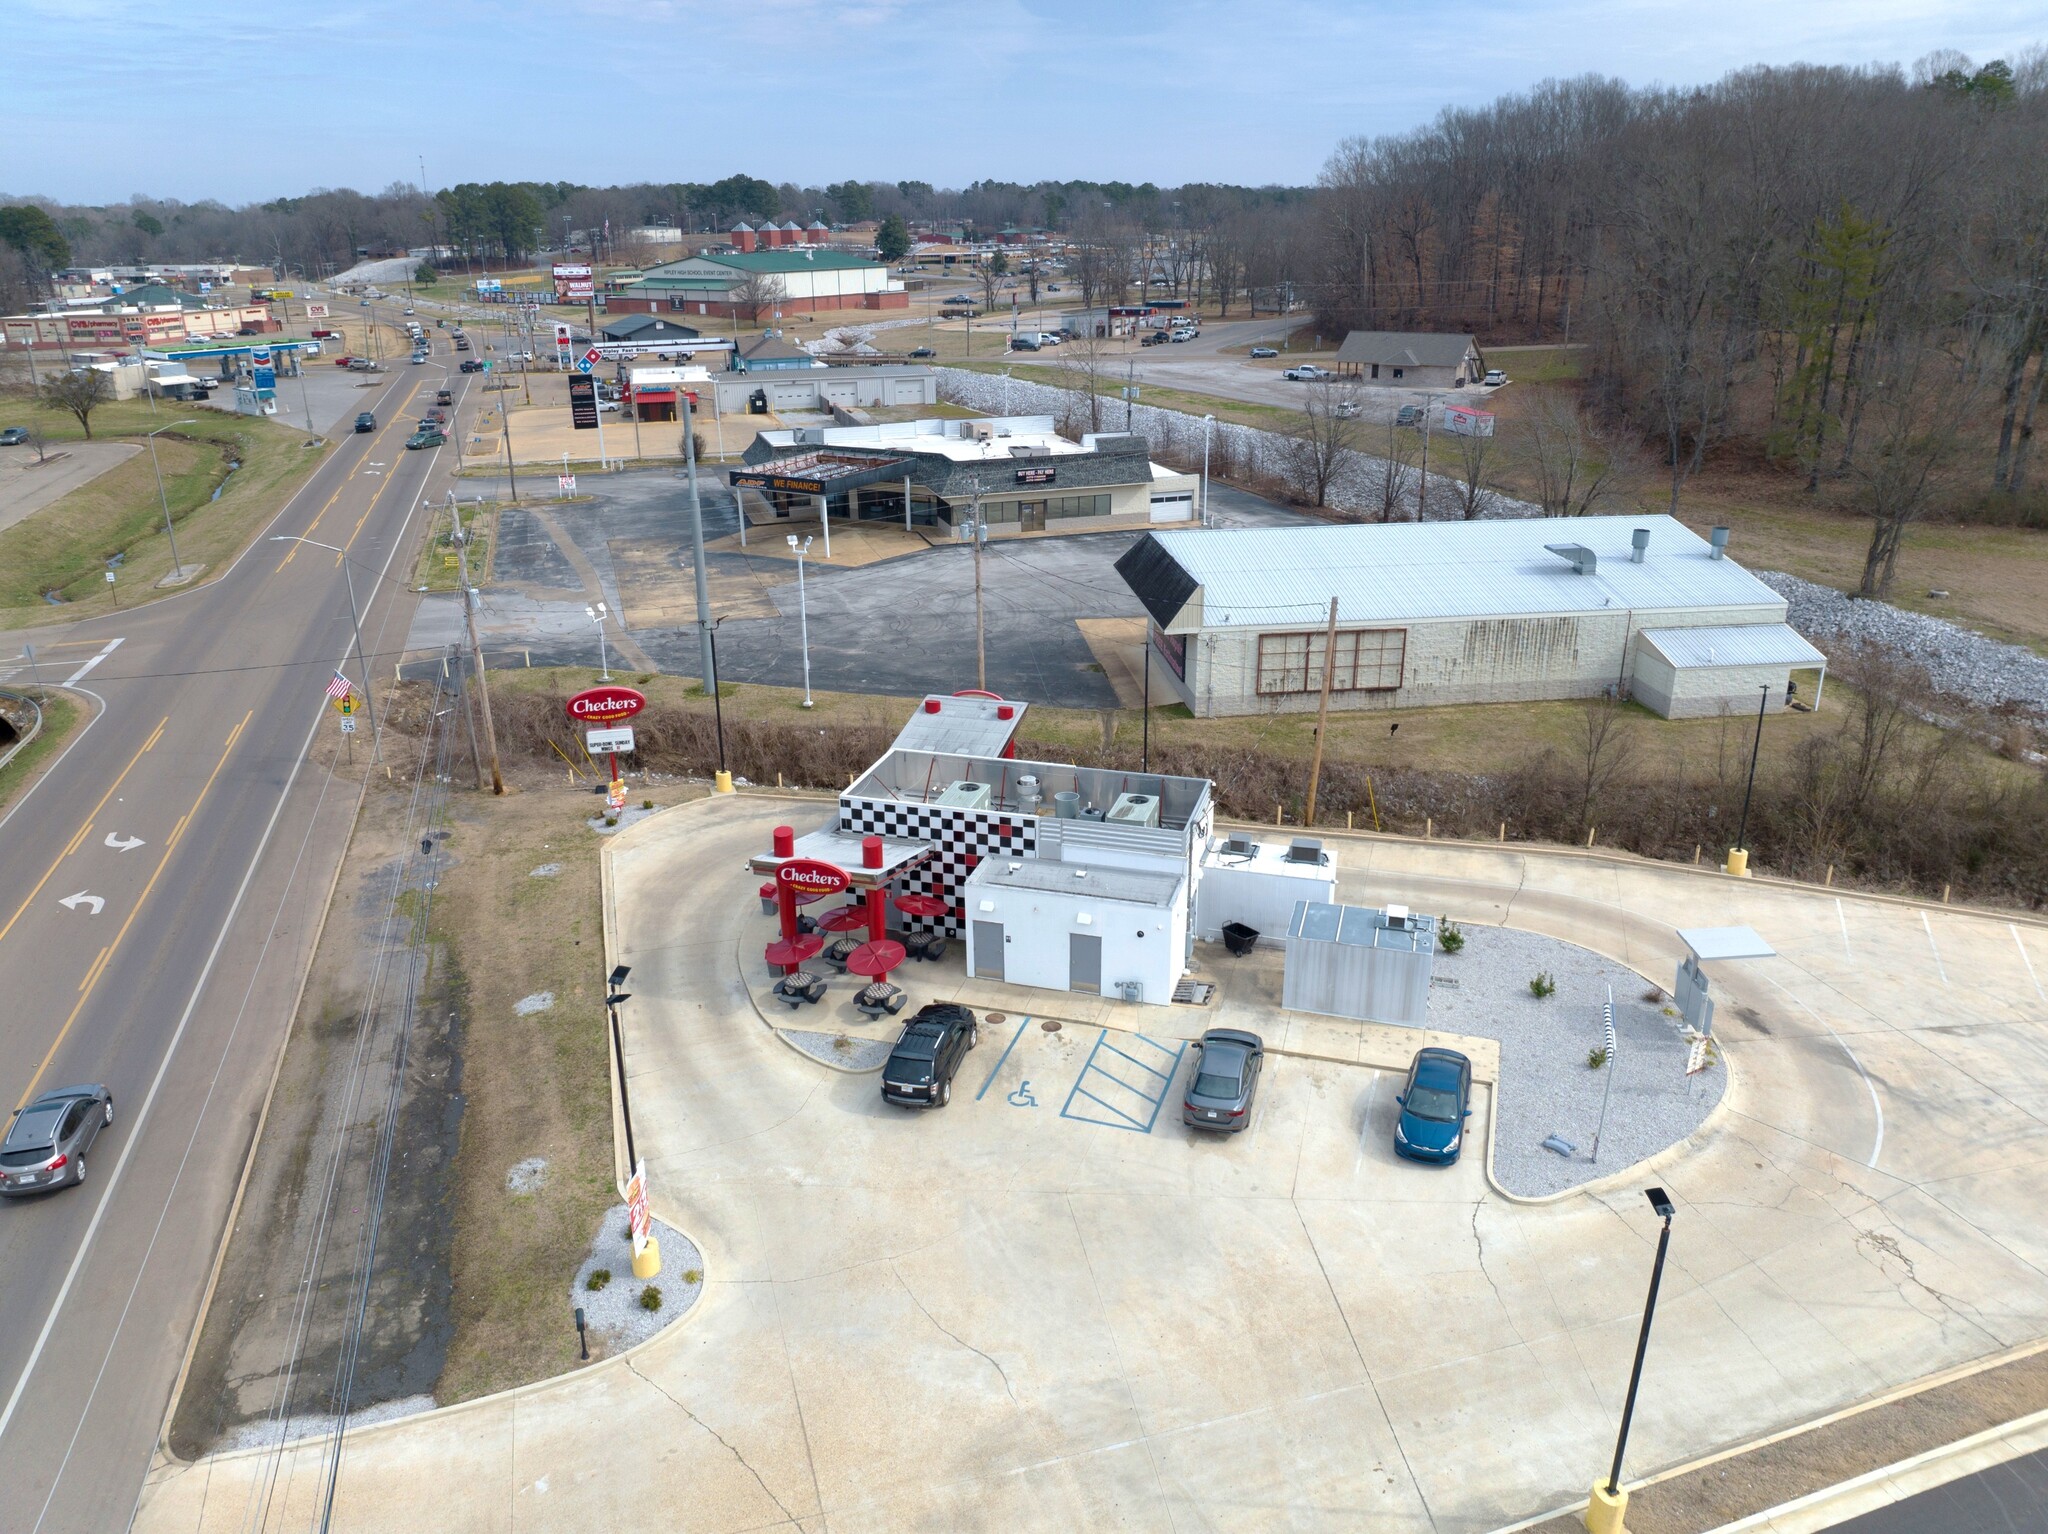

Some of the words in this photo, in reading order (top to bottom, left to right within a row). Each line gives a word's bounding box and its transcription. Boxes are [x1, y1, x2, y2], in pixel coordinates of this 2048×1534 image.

[773, 479, 785, 488] WE
[787, 480, 821, 492] FINANCE!
[573, 697, 637, 713] Checkers
[781, 867, 841, 886] Checkers
